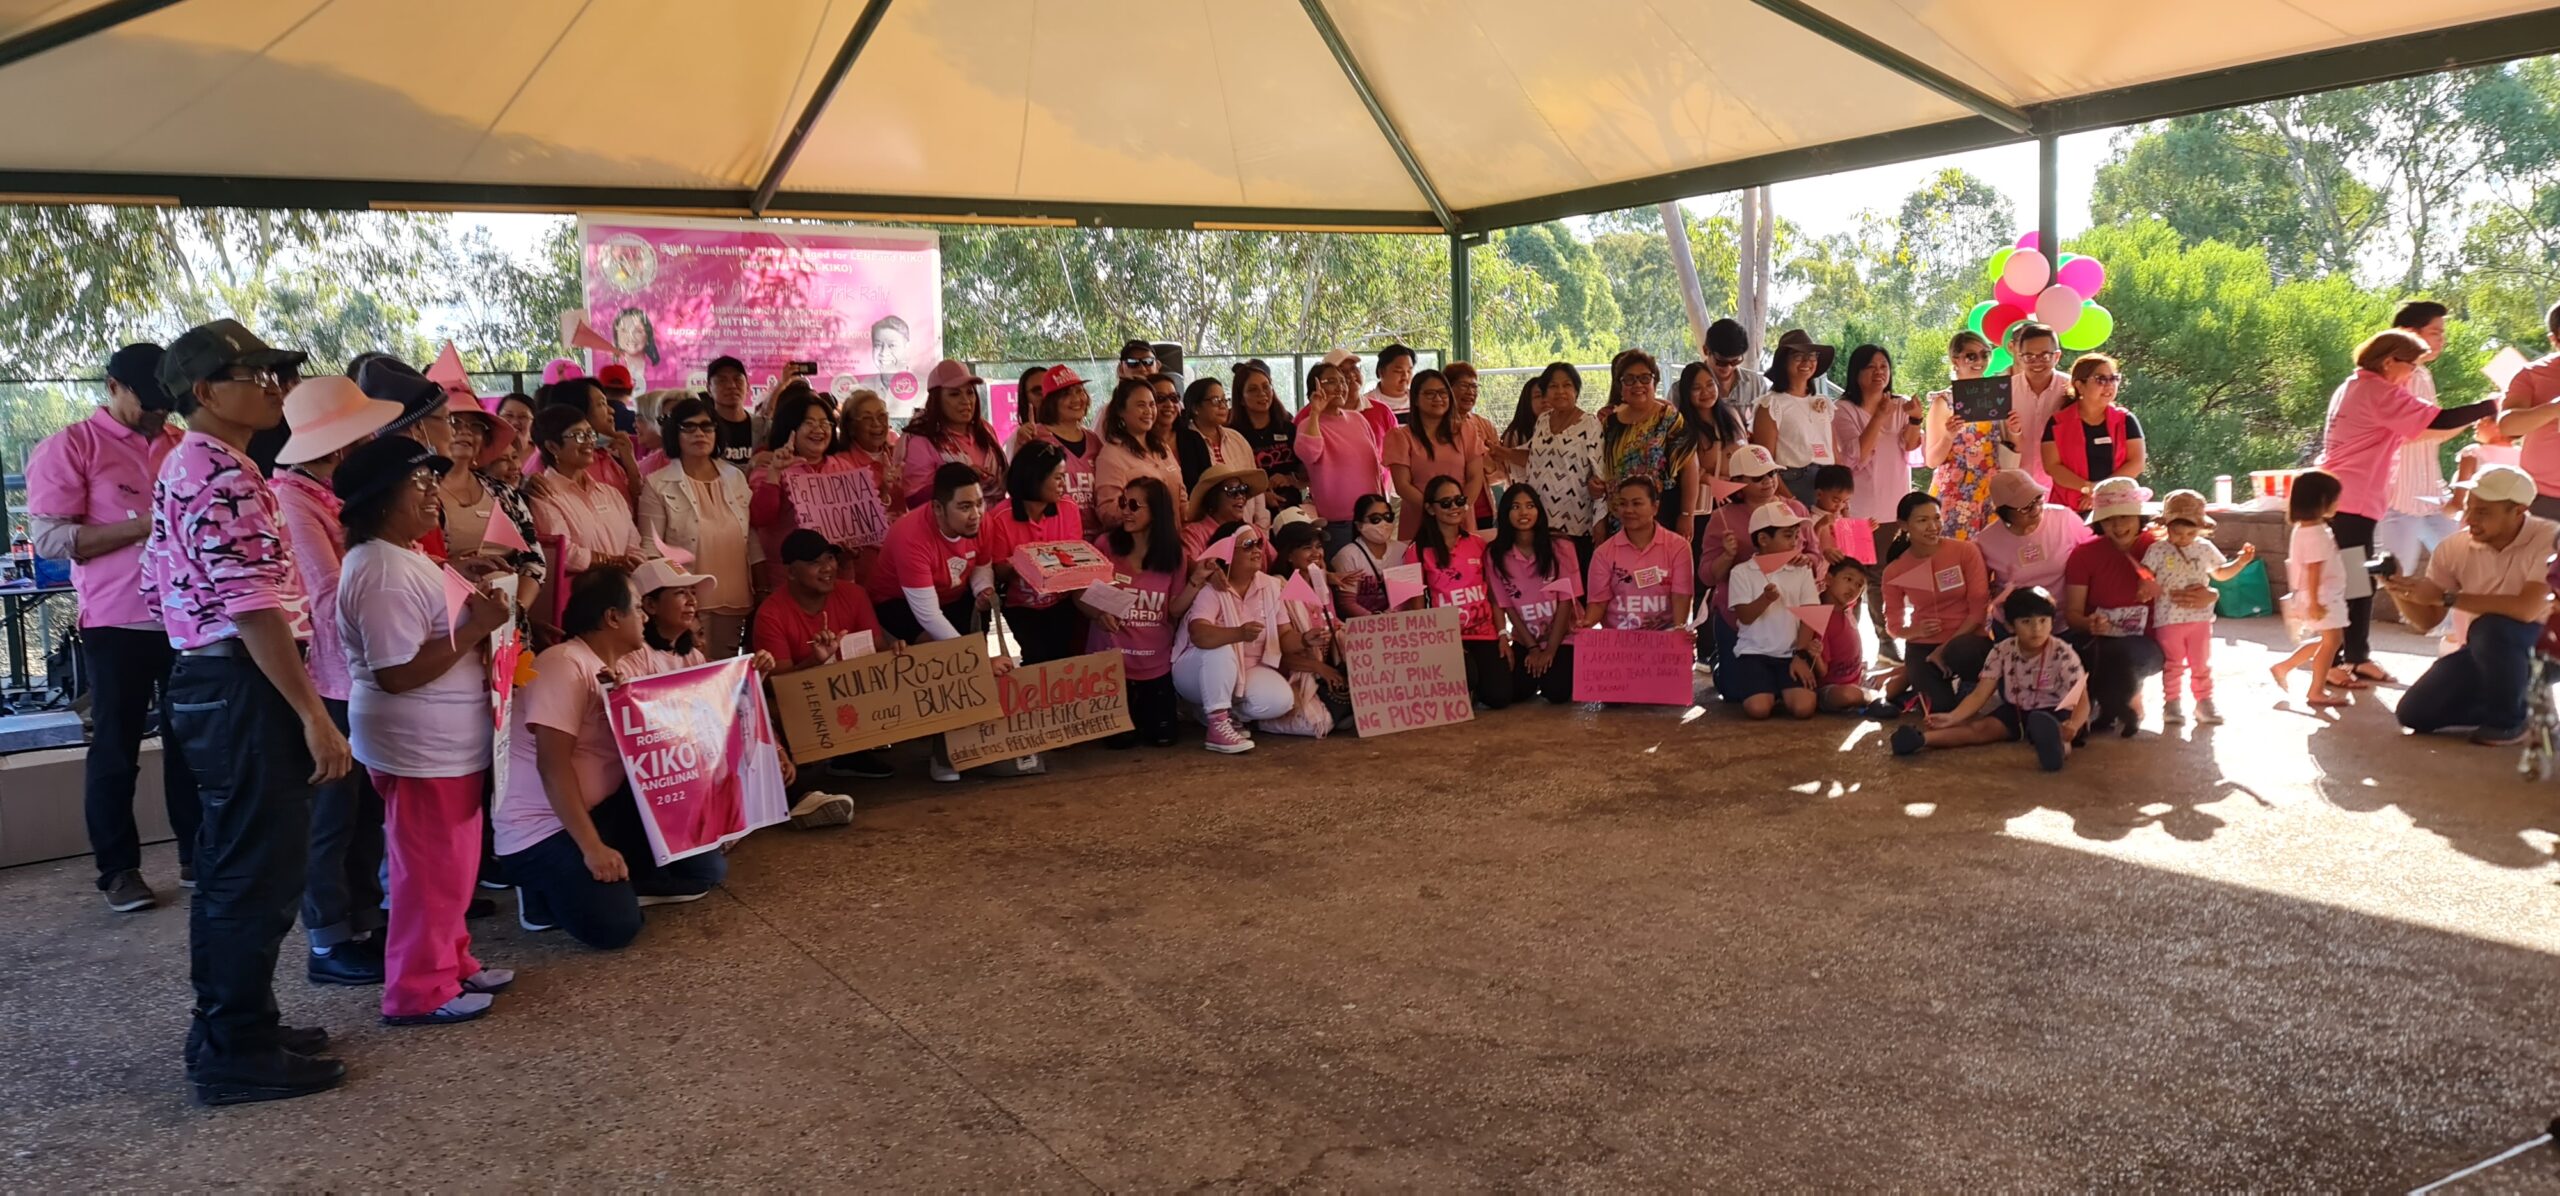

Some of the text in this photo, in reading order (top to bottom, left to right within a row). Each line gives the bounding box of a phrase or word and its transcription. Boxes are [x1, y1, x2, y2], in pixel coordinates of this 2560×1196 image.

[695, 244, 752, 257] Australian
[718, 316, 760, 328] MITING
[779, 318, 823, 329] AVANCE
[723, 328, 739, 337] the
[741, 328, 791, 340] Candidacy
[807, 471, 875, 506] FILIPINA
[818, 500, 888, 542] ILOCANA
[1438, 585, 1485, 608] LENI
[1615, 595, 1668, 613] LENI
[1346, 613, 1438, 635] AUSSIE MAN
[1345, 628, 1457, 653] ANG PASSPORT
[1382, 651, 1420, 665] PERO
[827, 645, 980, 701] KULAY Rosas
[1350, 664, 1444, 688] KULAY PINK
[871, 675, 987, 730] ang BUKAS
[1352, 680, 1468, 708] IPINAGLALABAN
[802, 680, 835, 749] #LENIKIKO
[979, 722, 997, 743] for
[1088, 694, 1123, 714] 2022
[1357, 712, 1382, 731] NG
[1443, 700, 1470, 722] KO
[627, 742, 697, 781] KIKO
[639, 768, 700, 793] ANGILINAN
[656, 790, 687, 806] 2022
